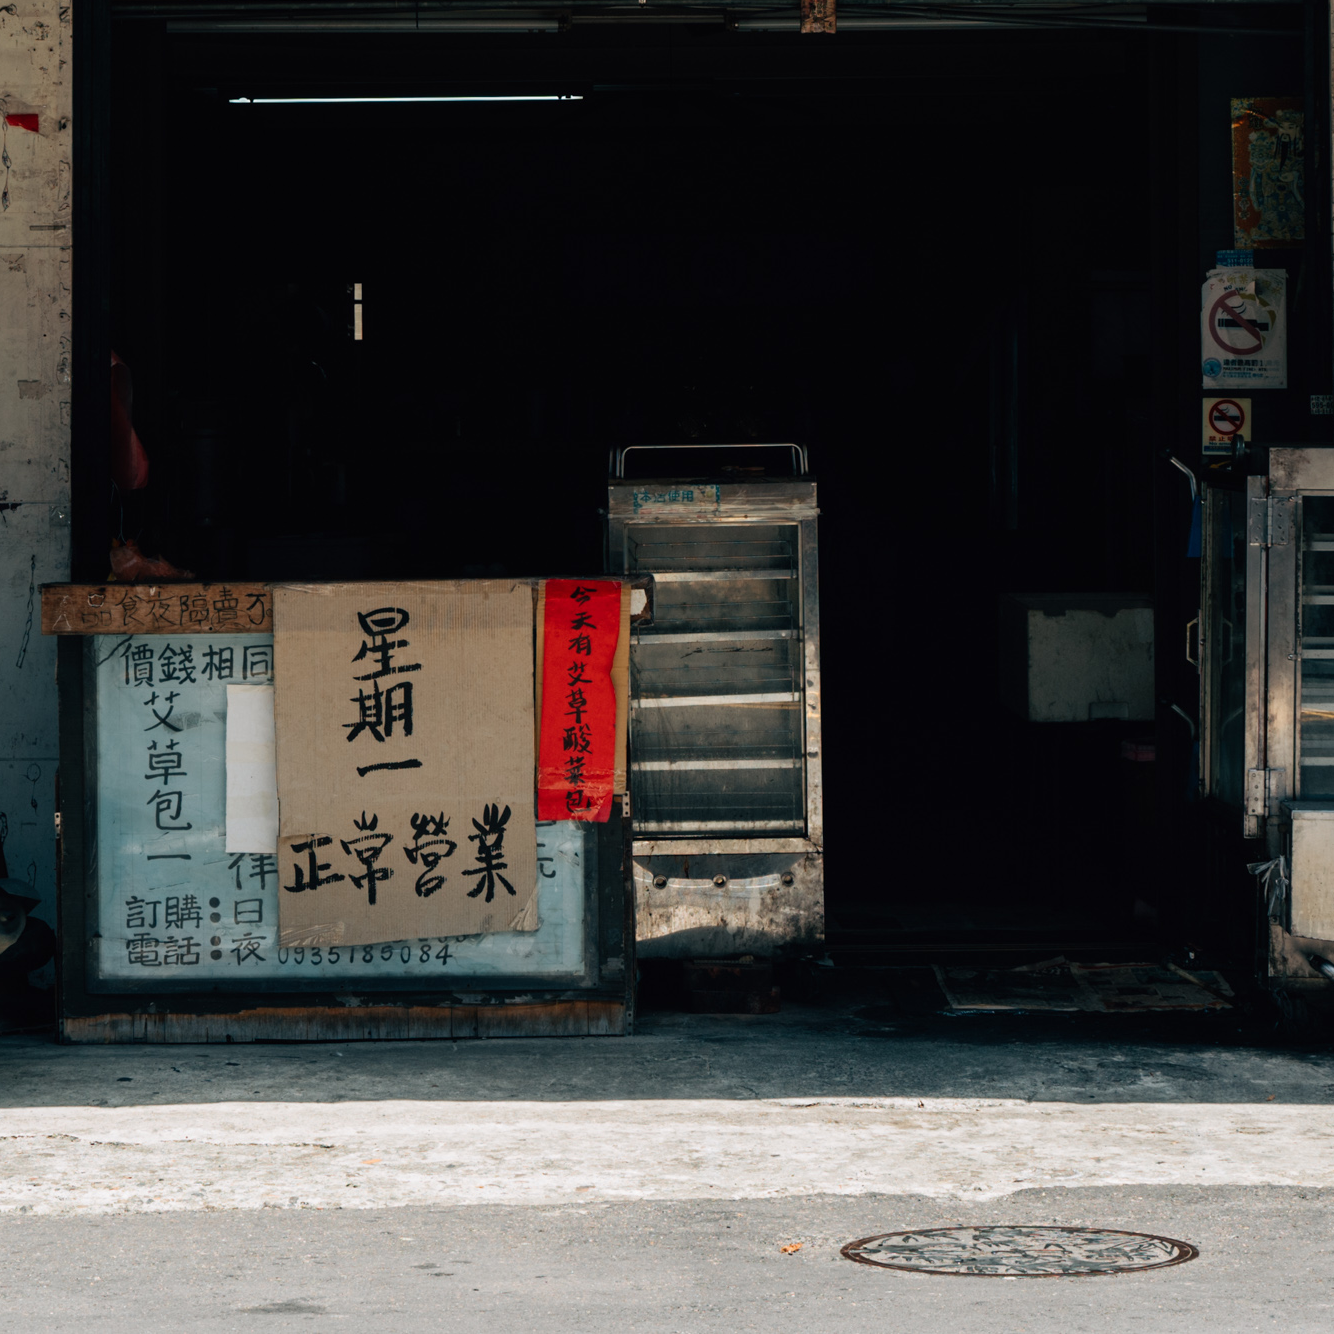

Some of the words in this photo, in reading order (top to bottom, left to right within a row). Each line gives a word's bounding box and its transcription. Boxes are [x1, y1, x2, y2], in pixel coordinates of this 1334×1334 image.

[120, 643, 274, 687] 價錢相同
[341, 606, 423, 779] 星期一
[283, 803, 518, 905] 正常營業
[277, 944, 454, 967] 0935185084
